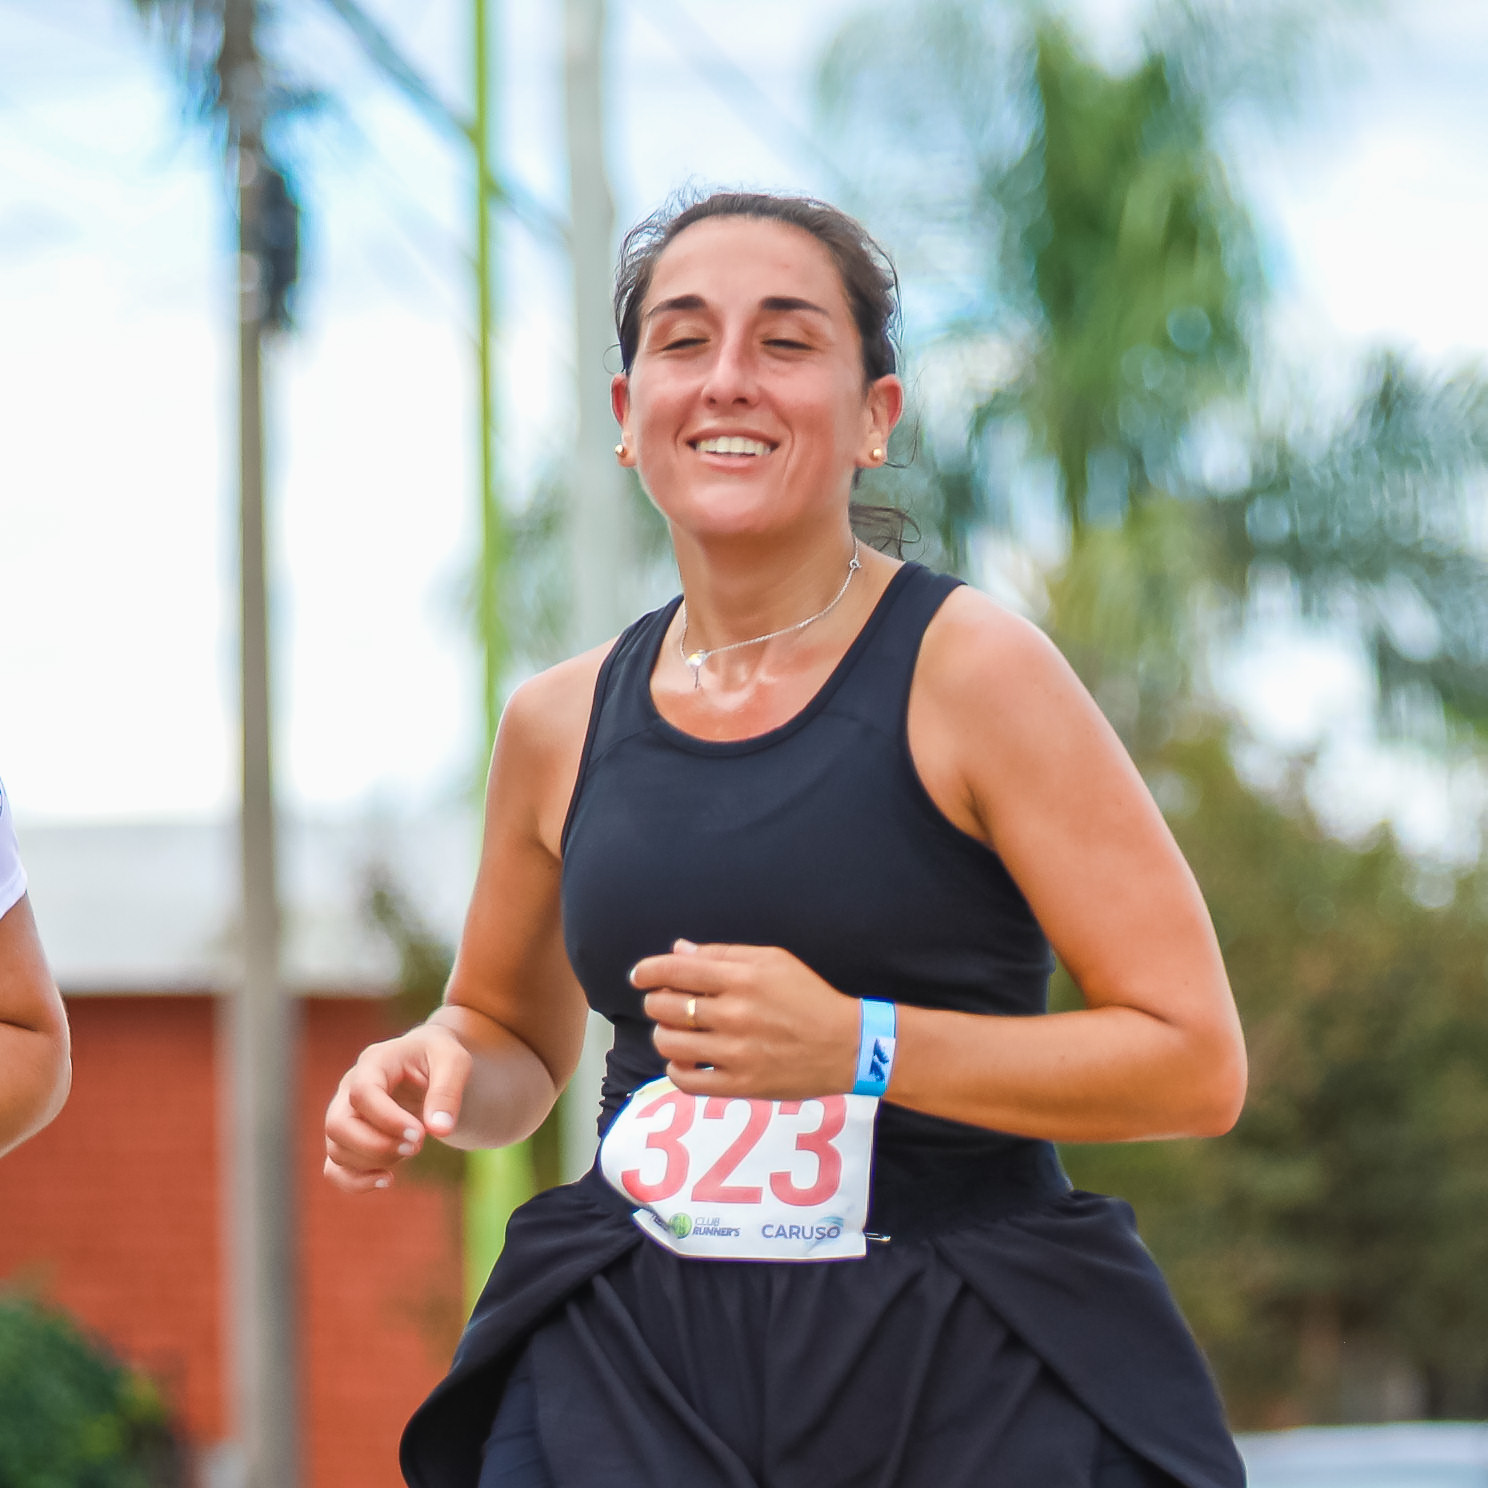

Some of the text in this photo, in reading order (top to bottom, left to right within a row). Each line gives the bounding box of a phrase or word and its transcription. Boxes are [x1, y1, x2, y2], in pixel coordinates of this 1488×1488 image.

[621, 1090, 847, 1207] 323
[695, 1217, 721, 1226] CLUB
[692, 1226, 741, 1237] RUNNER'S
[761, 1223, 841, 1241] CARUSO
